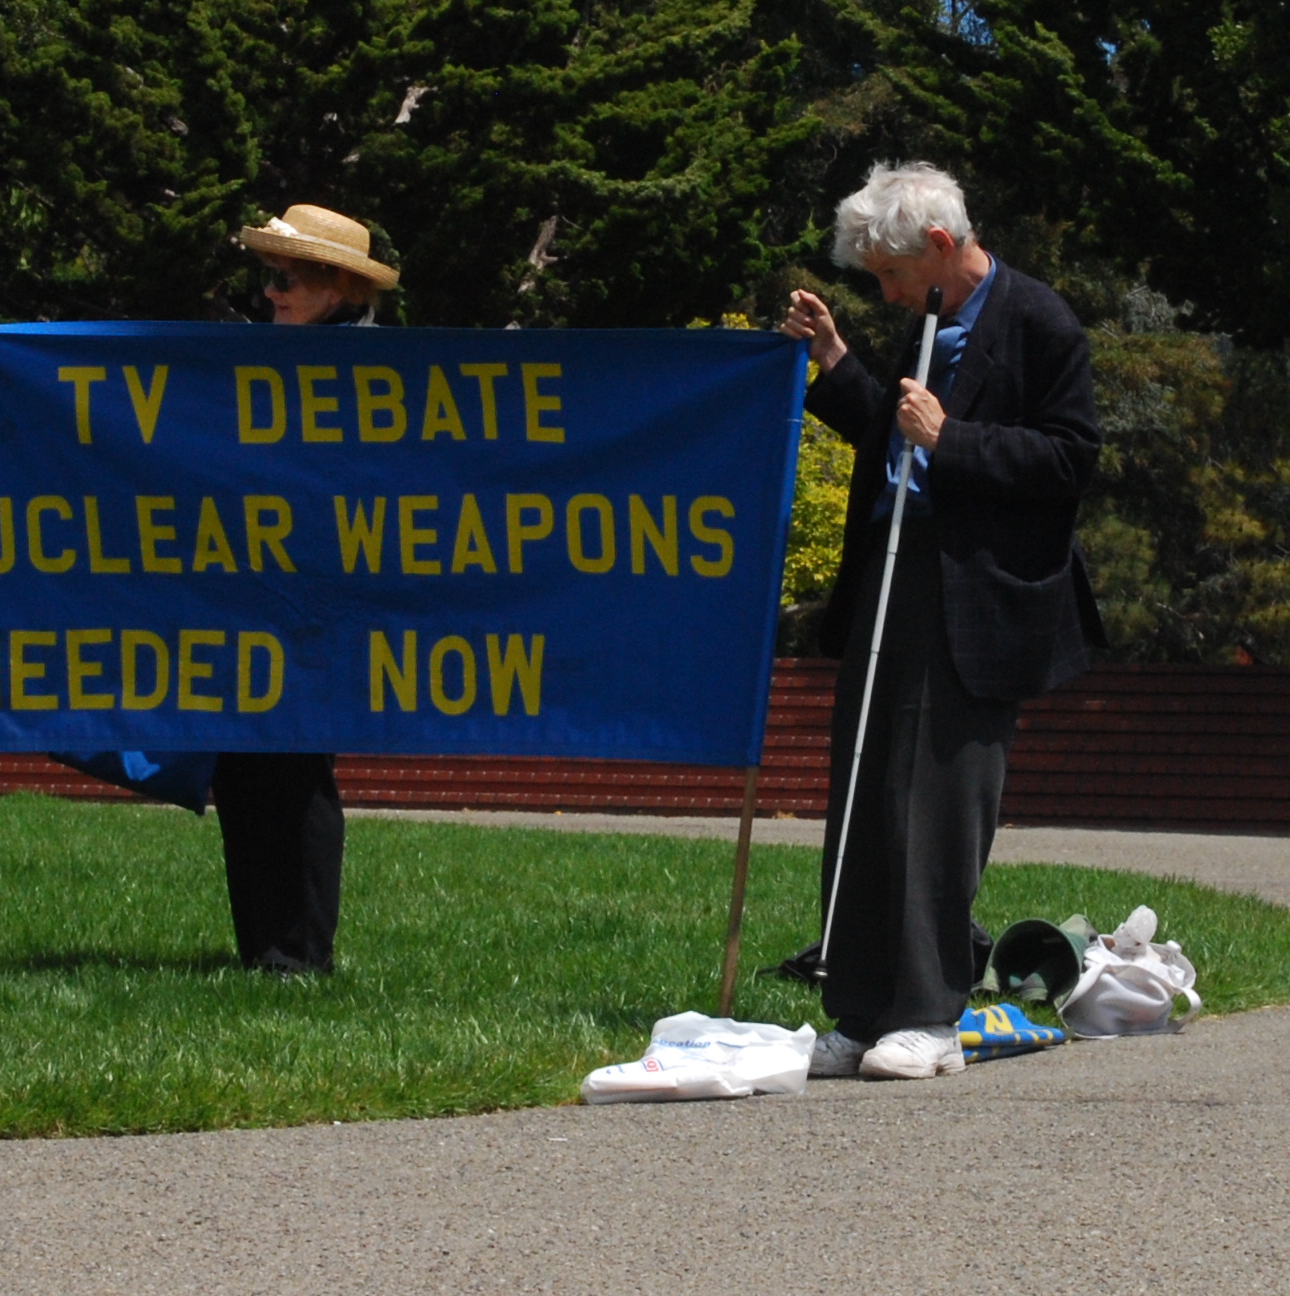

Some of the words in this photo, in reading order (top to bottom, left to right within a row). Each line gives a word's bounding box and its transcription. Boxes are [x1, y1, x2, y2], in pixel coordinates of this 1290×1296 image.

[58, 364, 169, 444] TV
[234, 363, 566, 444] DEBATE
[334, 493, 736, 578] WEAPONS
[368, 630, 545, 717] NOW
